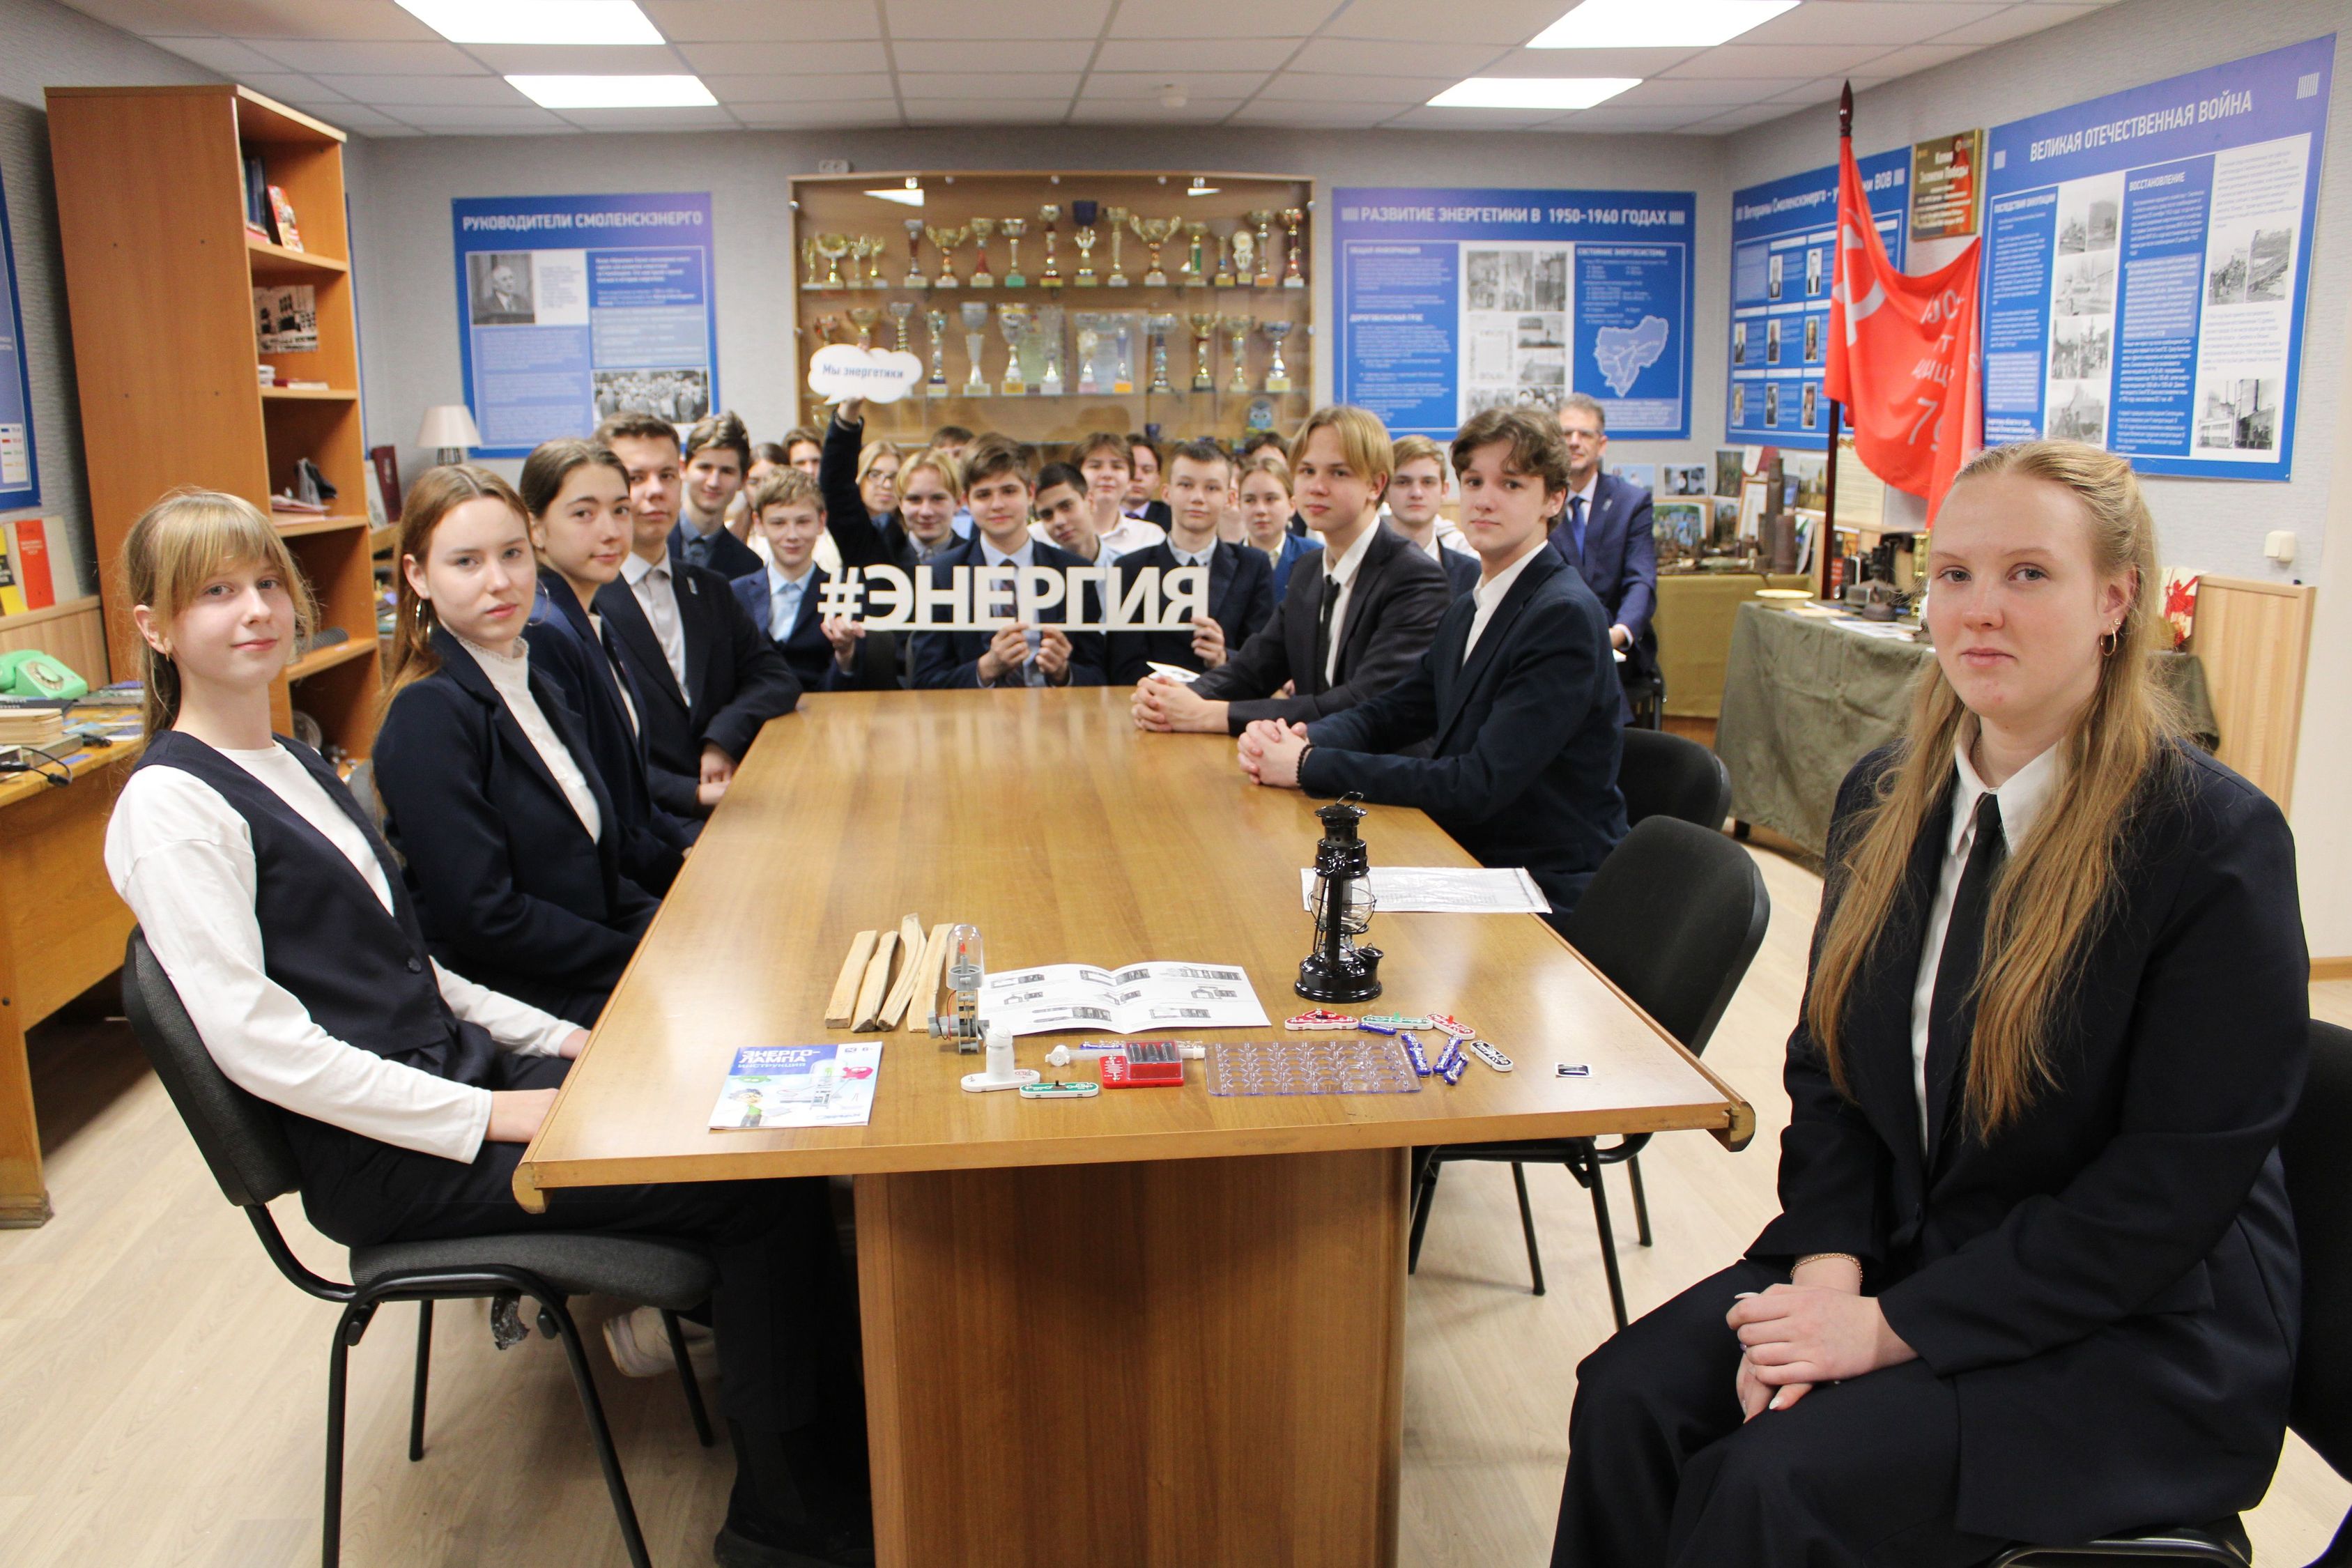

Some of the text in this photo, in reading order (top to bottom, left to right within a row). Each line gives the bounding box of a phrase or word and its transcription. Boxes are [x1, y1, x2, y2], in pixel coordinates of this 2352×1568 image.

[2029, 90, 2252, 162] ВЕЛИКАЯ ОТЕЧЕСТВЕННАЯ ВОЙНА
[1875, 171, 1893, 190] ВОВ
[2129, 171, 2185, 192] ВОССТАНОВЛЕНИЕ
[463, 211, 703, 232] РУКОВОДИТЕЛИ СМОЛЕНСКЭНЕРГО
[1361, 207, 1666, 226] РАЗВИТИЕ ЭНЕРГЕТИКИ В 1950-1960 ГОДАХ
[822, 363, 903, 380] Мы энергетики
[817, 564, 1209, 629] #ЭНЕРГИЯ
